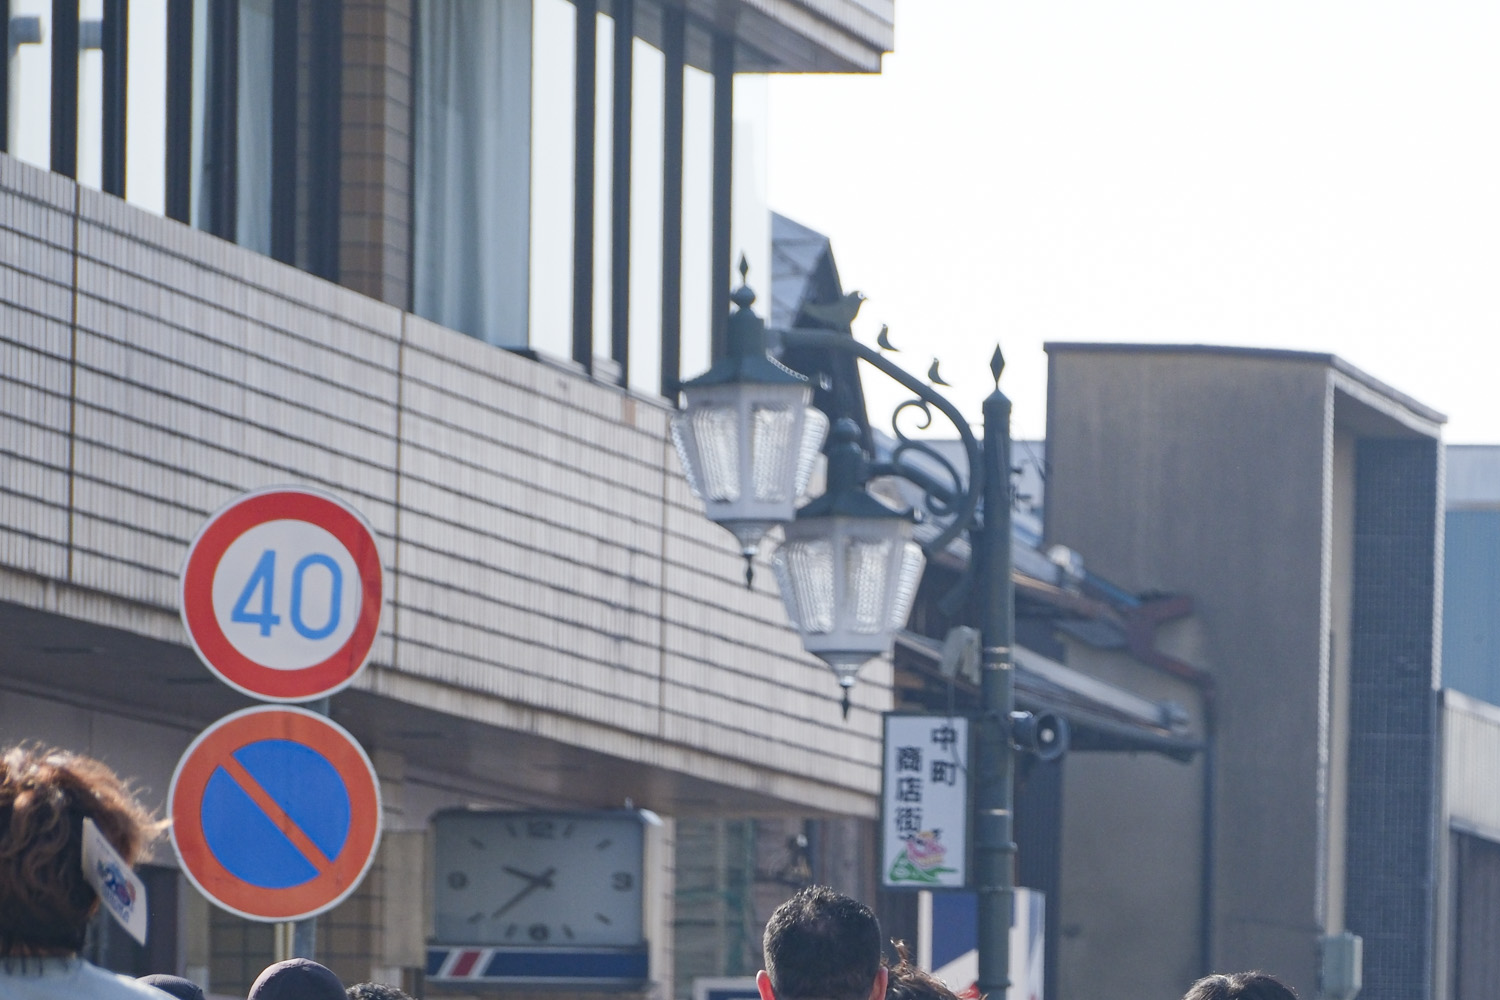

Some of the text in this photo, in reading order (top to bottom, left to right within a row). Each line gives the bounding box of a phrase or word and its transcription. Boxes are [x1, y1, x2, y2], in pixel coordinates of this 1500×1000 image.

[230, 548, 343, 641] 40
[895, 745, 922, 841] 商店街
[930, 725, 957, 787] 中町
